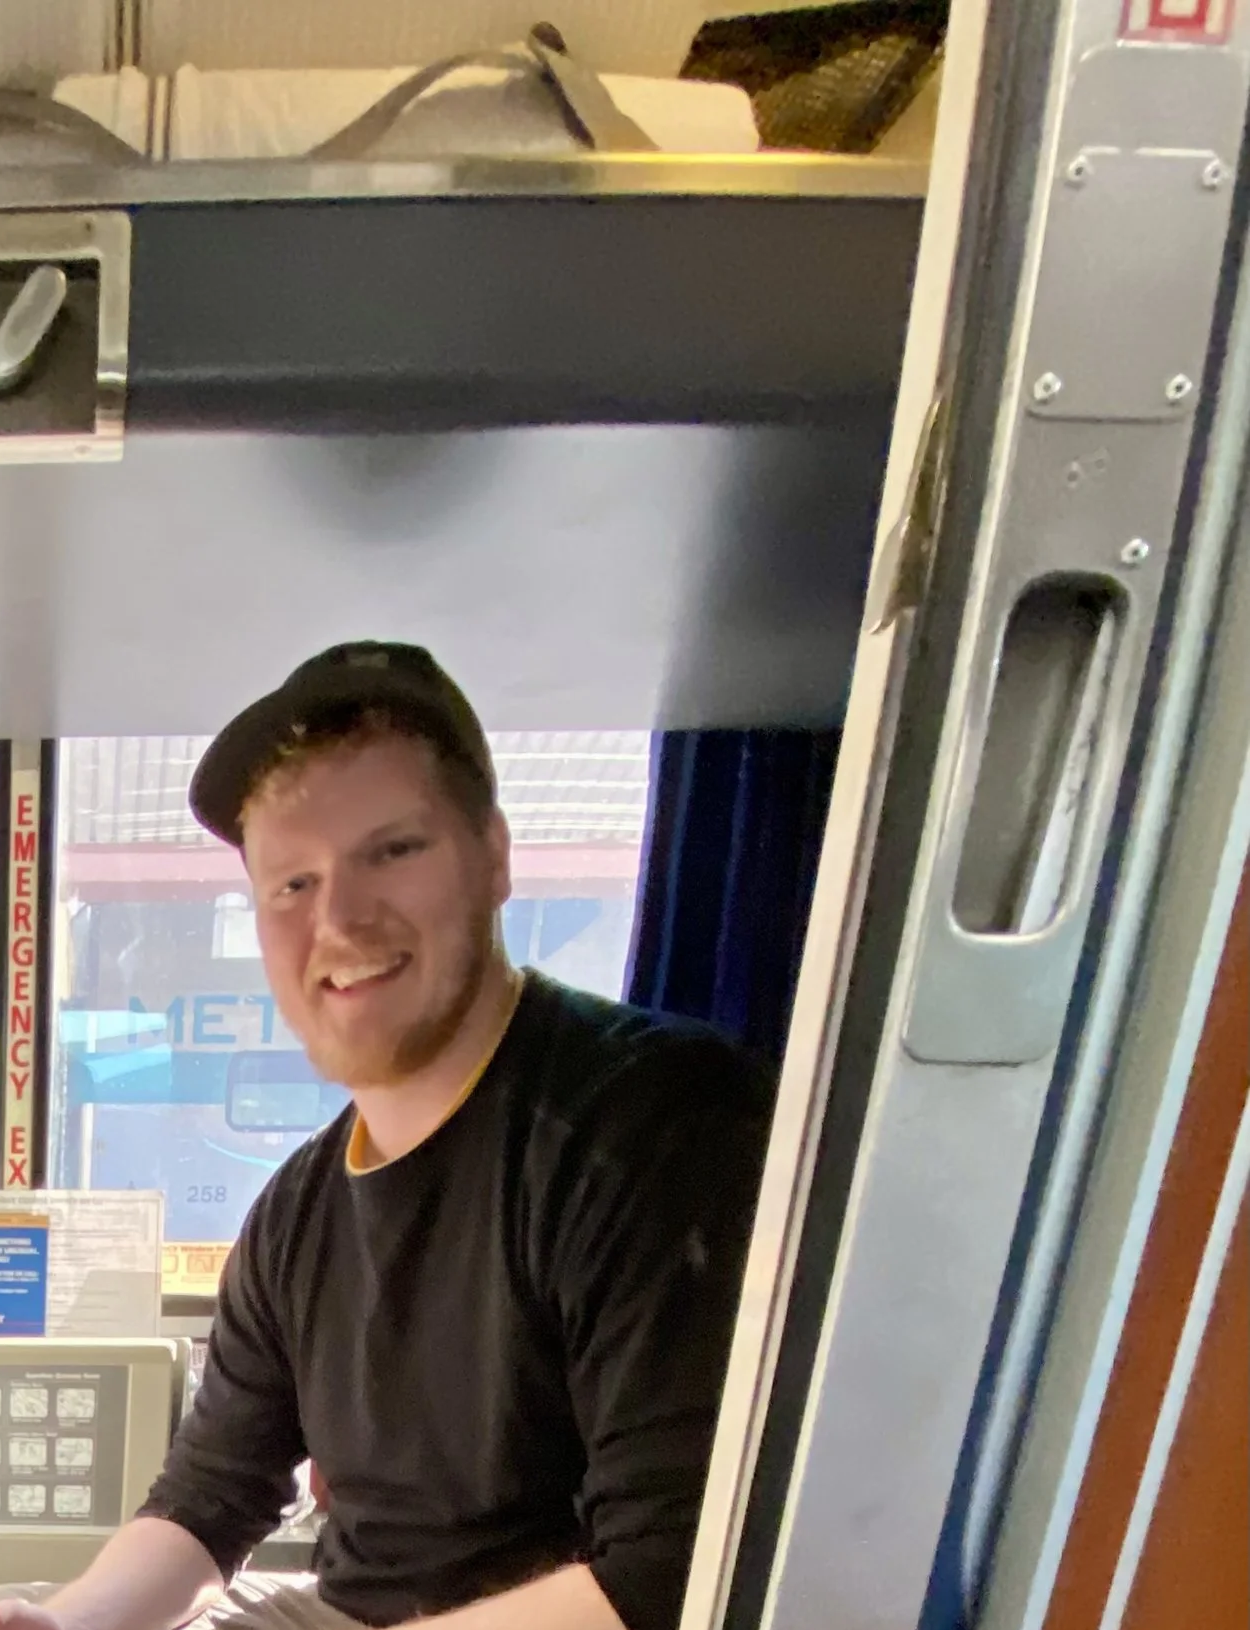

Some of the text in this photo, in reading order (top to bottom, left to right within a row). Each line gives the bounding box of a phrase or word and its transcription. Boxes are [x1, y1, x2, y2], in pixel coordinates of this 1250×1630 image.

[10, 794, 36, 1100] EMERGENCY
[127, 995, 275, 1044] MET
[186, 1185, 227, 1203] 258
